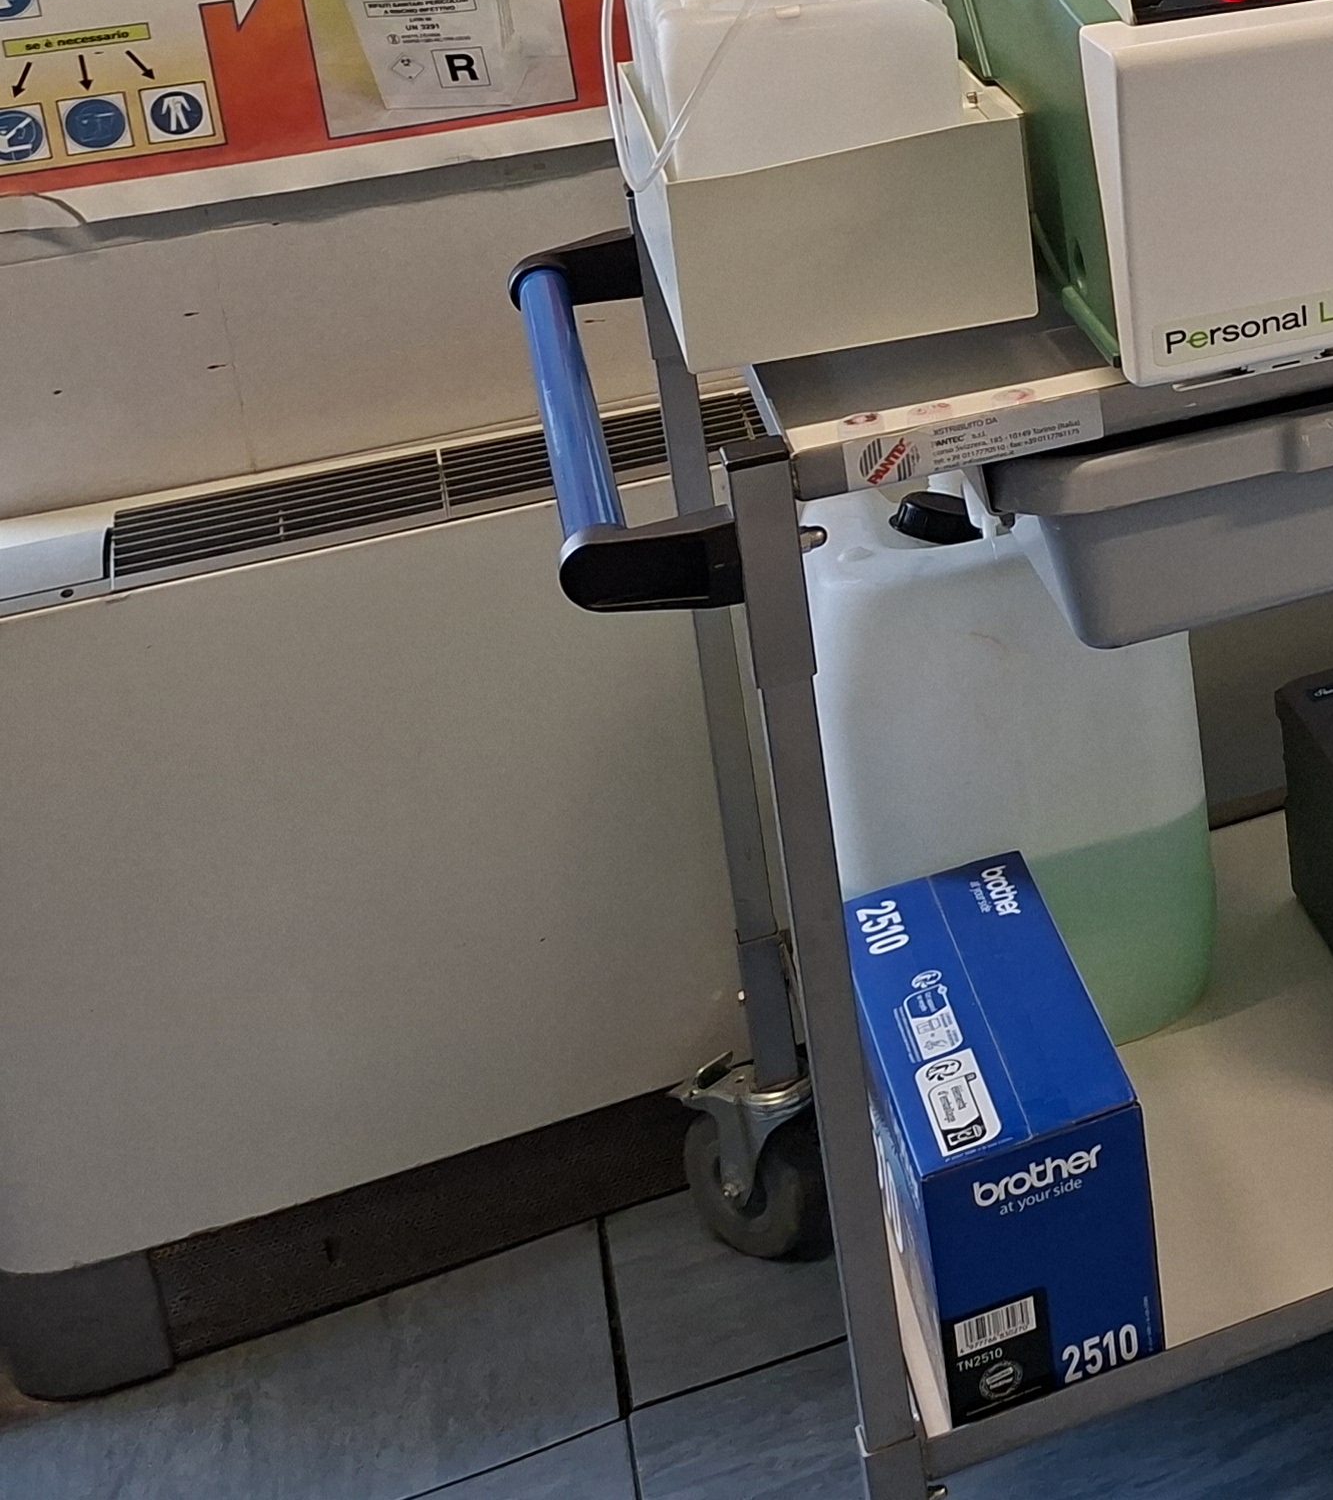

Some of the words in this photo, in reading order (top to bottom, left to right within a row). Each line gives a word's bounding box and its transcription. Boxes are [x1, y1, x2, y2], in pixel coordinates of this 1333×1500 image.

[58, 30, 129, 46] necessario
[1165, 304, 1308, 354] Personal
[986, 417, 998, 425] DA
[1033, 425, 1056, 435] Torino
[981, 865, 1021, 916] brother
[856, 900, 910, 955] 2510
[973, 1144, 1101, 1207] brother
[1000, 1201, 1014, 1215] at
[1017, 1188, 1051, 1212] your
[1053, 1179, 1082, 1197] side
[956, 1348, 1003, 1372] TN2510
[1062, 1324, 1139, 1384] 2510
